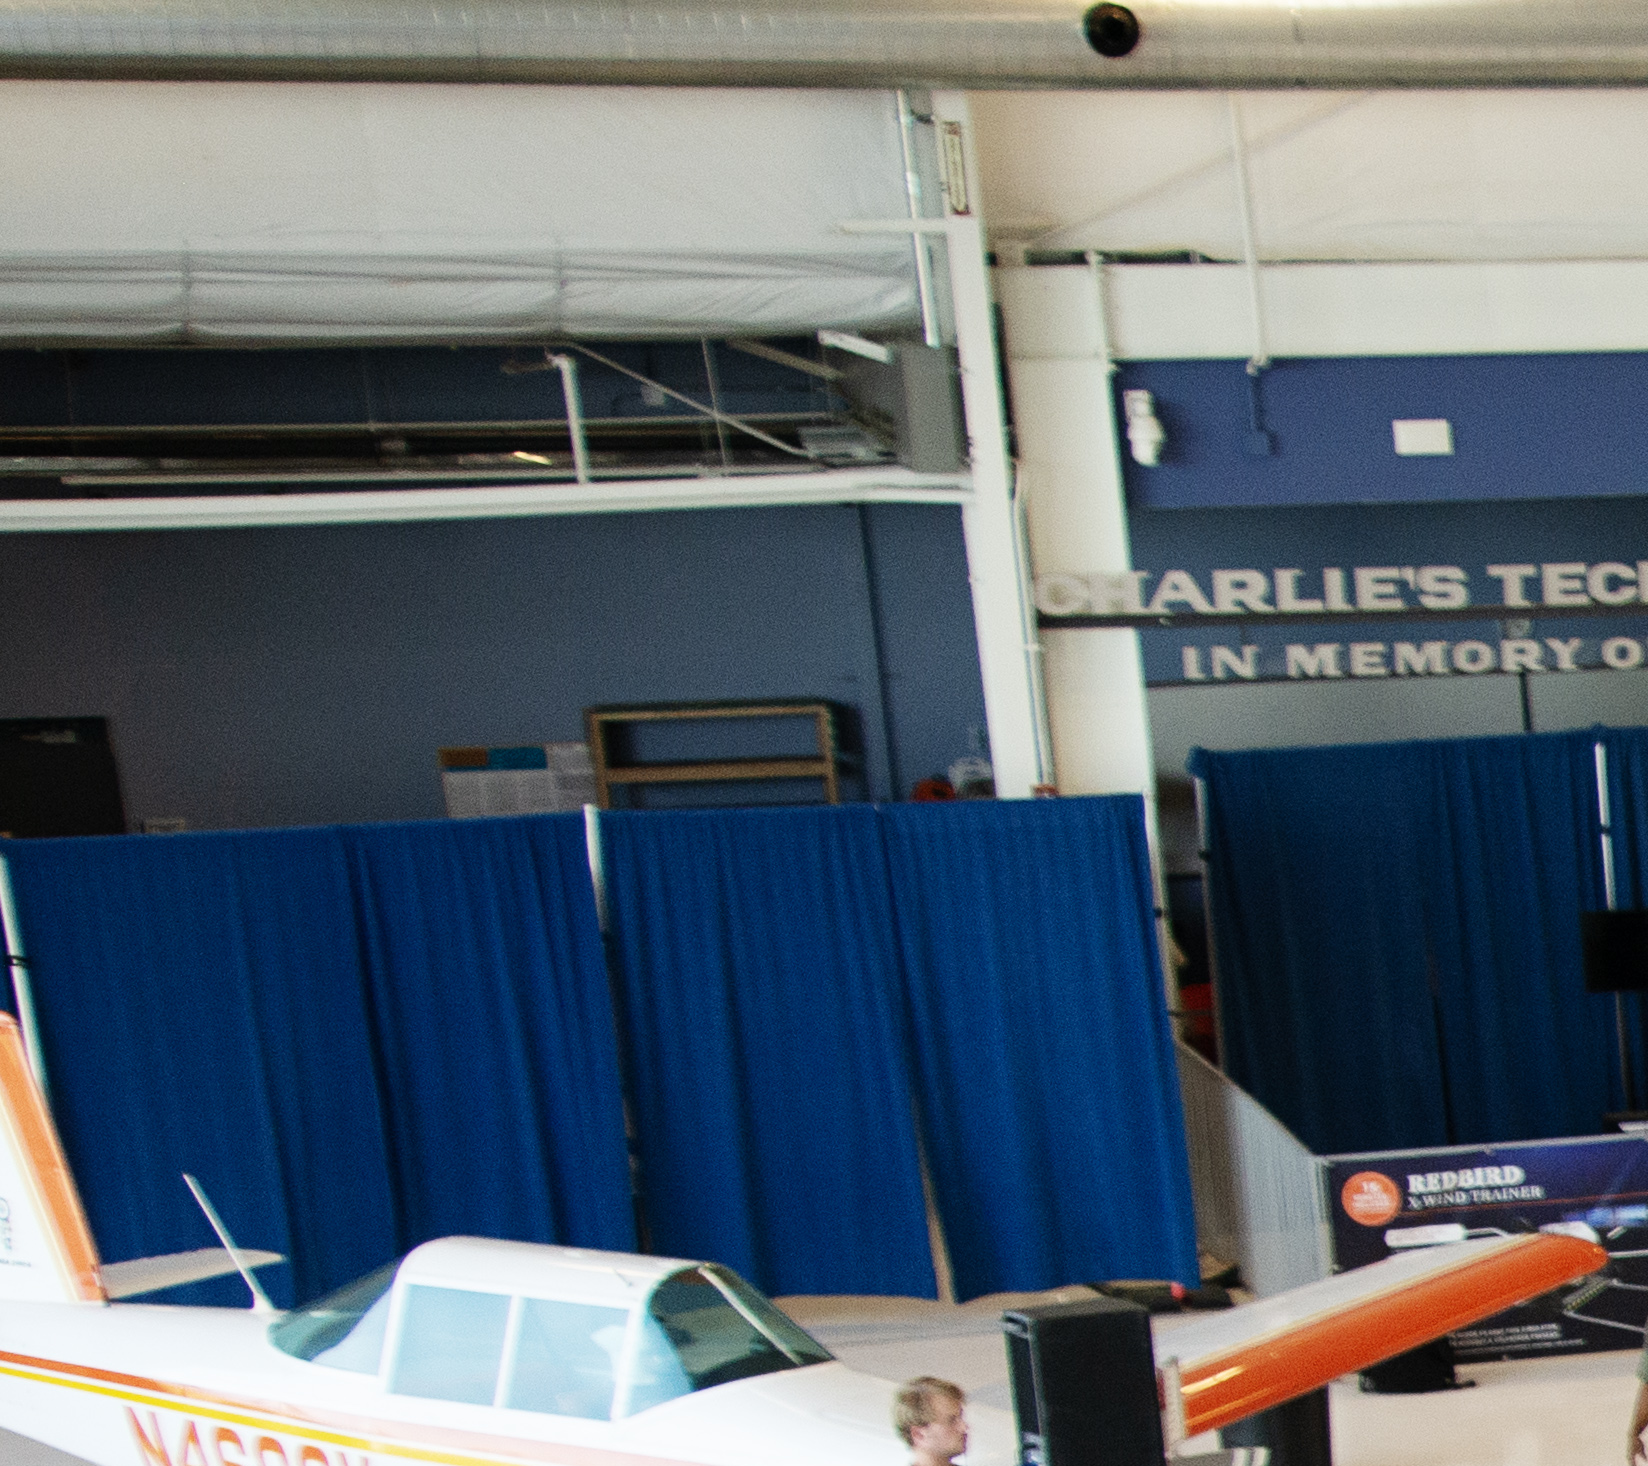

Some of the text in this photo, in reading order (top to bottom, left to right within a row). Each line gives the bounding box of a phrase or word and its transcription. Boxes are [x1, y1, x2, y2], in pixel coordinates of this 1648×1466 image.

[1033, 563, 1469, 616] CHARLIE'S
[1182, 643, 1258, 681] IN
[1286, 635, 1485, 679] MEMORY
[1407, 1164, 1526, 1195] REDBIRD
[1470, 1184, 1544, 1205] TRAINER
